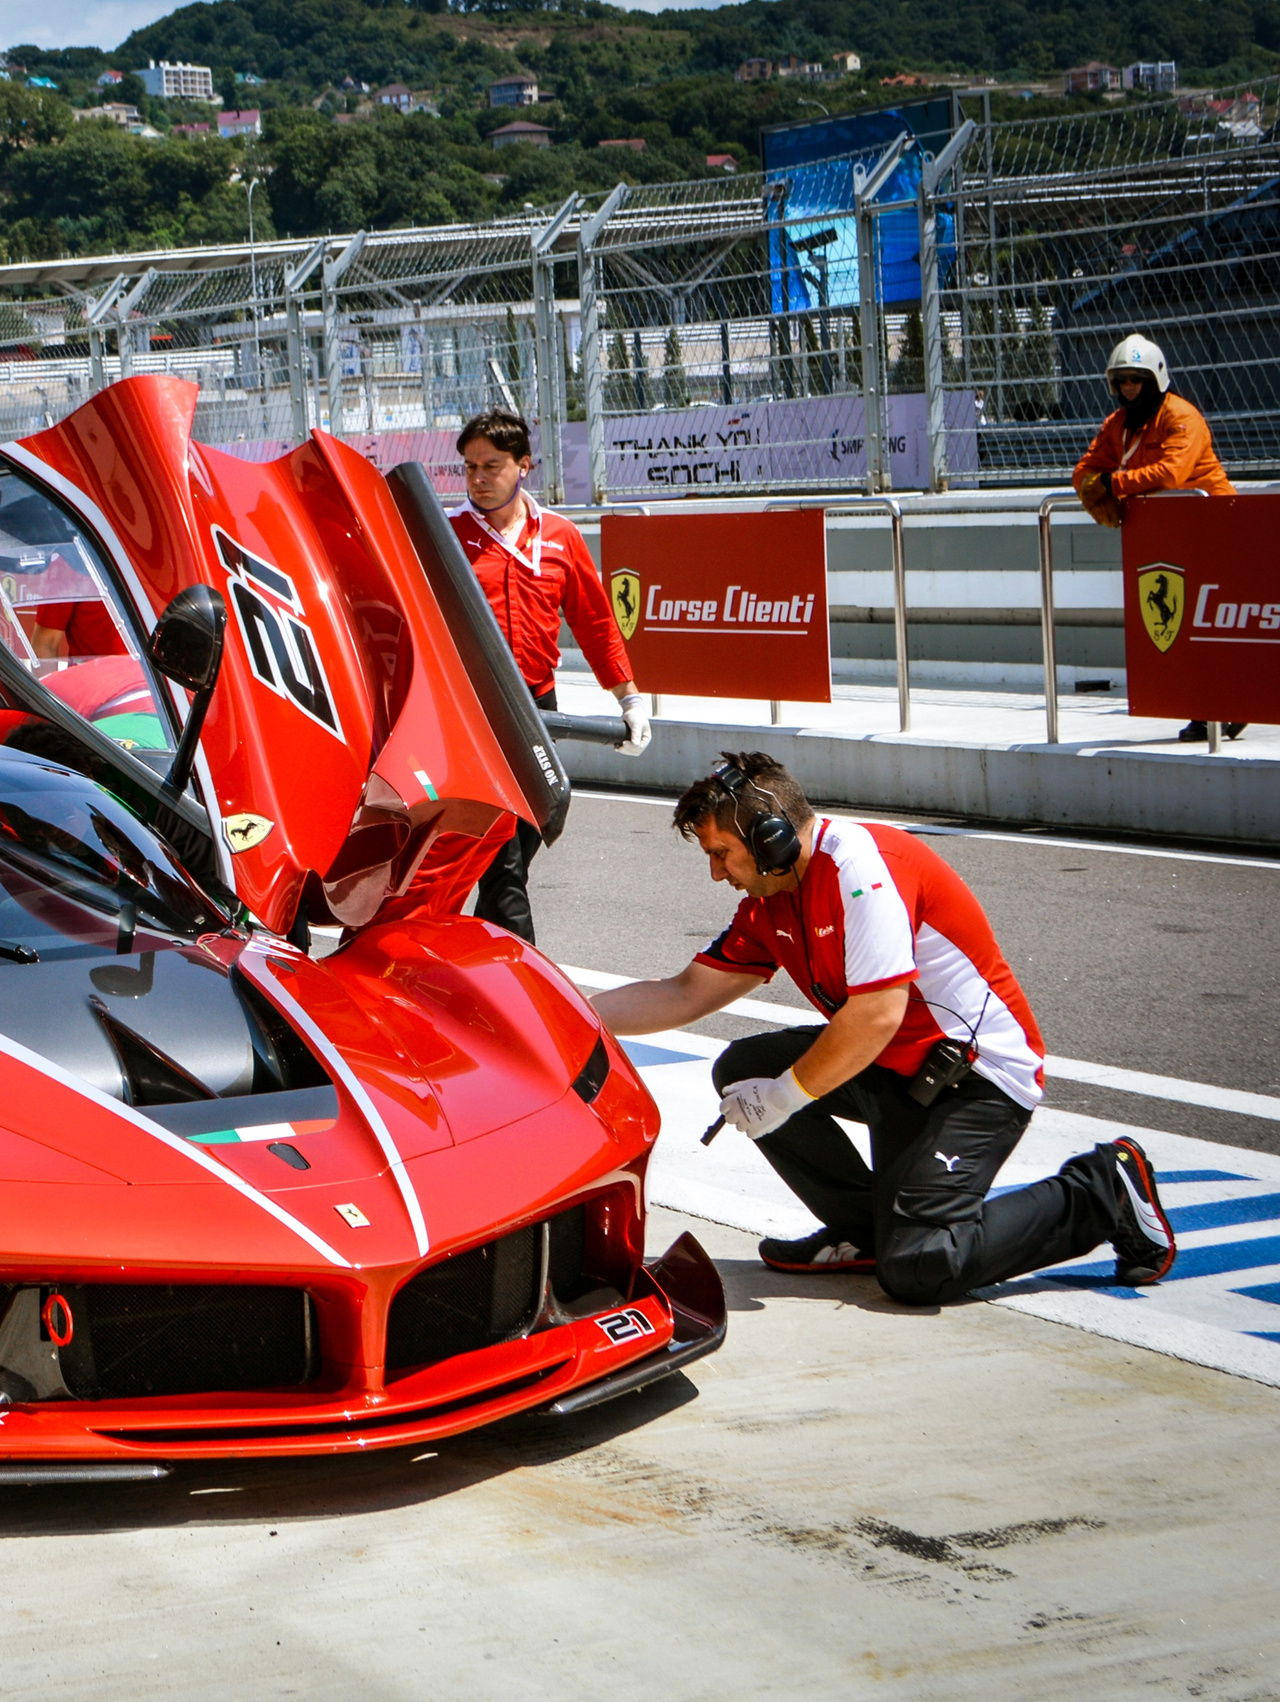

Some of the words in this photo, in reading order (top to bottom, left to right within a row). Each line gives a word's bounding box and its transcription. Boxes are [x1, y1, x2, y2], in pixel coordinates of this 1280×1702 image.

[613, 433, 708, 461] THANK
[716, 428, 761, 452] YOU
[646, 460, 740, 486] SOCHI
[645, 584, 718, 622] Corse
[722, 585, 816, 624] Clienti
[1192, 583, 1280, 629] Cors
[211, 523, 347, 746] 21
[532, 745, 552, 771] STEP
[544, 769, 559, 786] NO
[593, 1307, 656, 1346] 21
